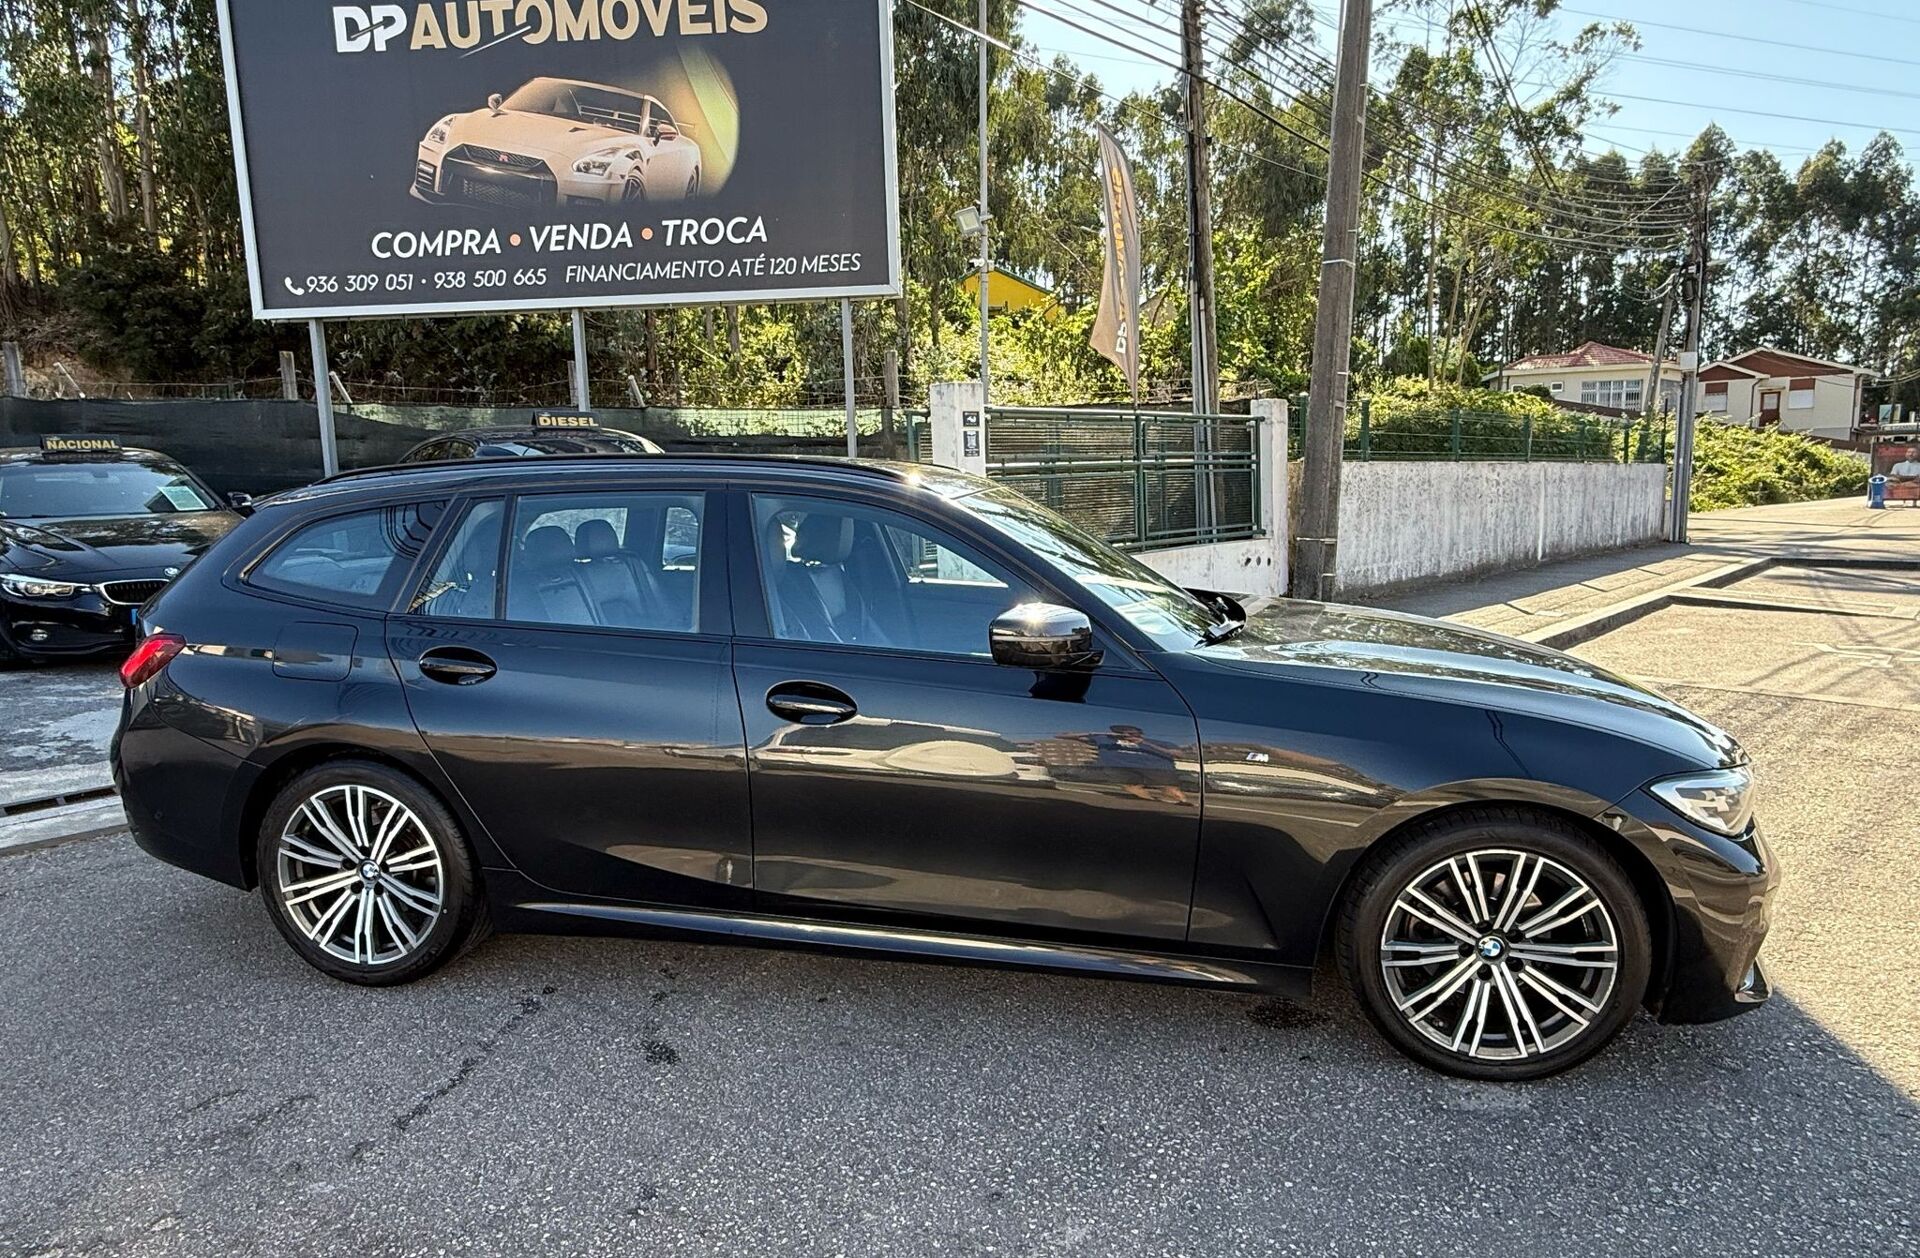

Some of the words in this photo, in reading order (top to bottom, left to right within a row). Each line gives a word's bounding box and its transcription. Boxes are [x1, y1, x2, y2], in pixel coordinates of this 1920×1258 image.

[371, 228, 502, 259] COMPRA
[529, 221, 634, 253] VENDA
[661, 215, 768, 247] TROCA
[306, 275, 339, 294] 936
[344, 273, 379, 292] 309
[385, 273, 414, 292] 051
[433, 271, 466, 290] 938
[472, 268, 507, 288] 500
[513, 267, 547, 286] 665
[565, 258, 725, 283] FINANCIAMENTO
[727, 253, 766, 277] ATÉ
[769, 257, 797, 276] 120
[801, 252, 862, 275] MESES
[538, 416, 599, 427] DIESEL
[46, 439, 119, 450] NACIONAL
